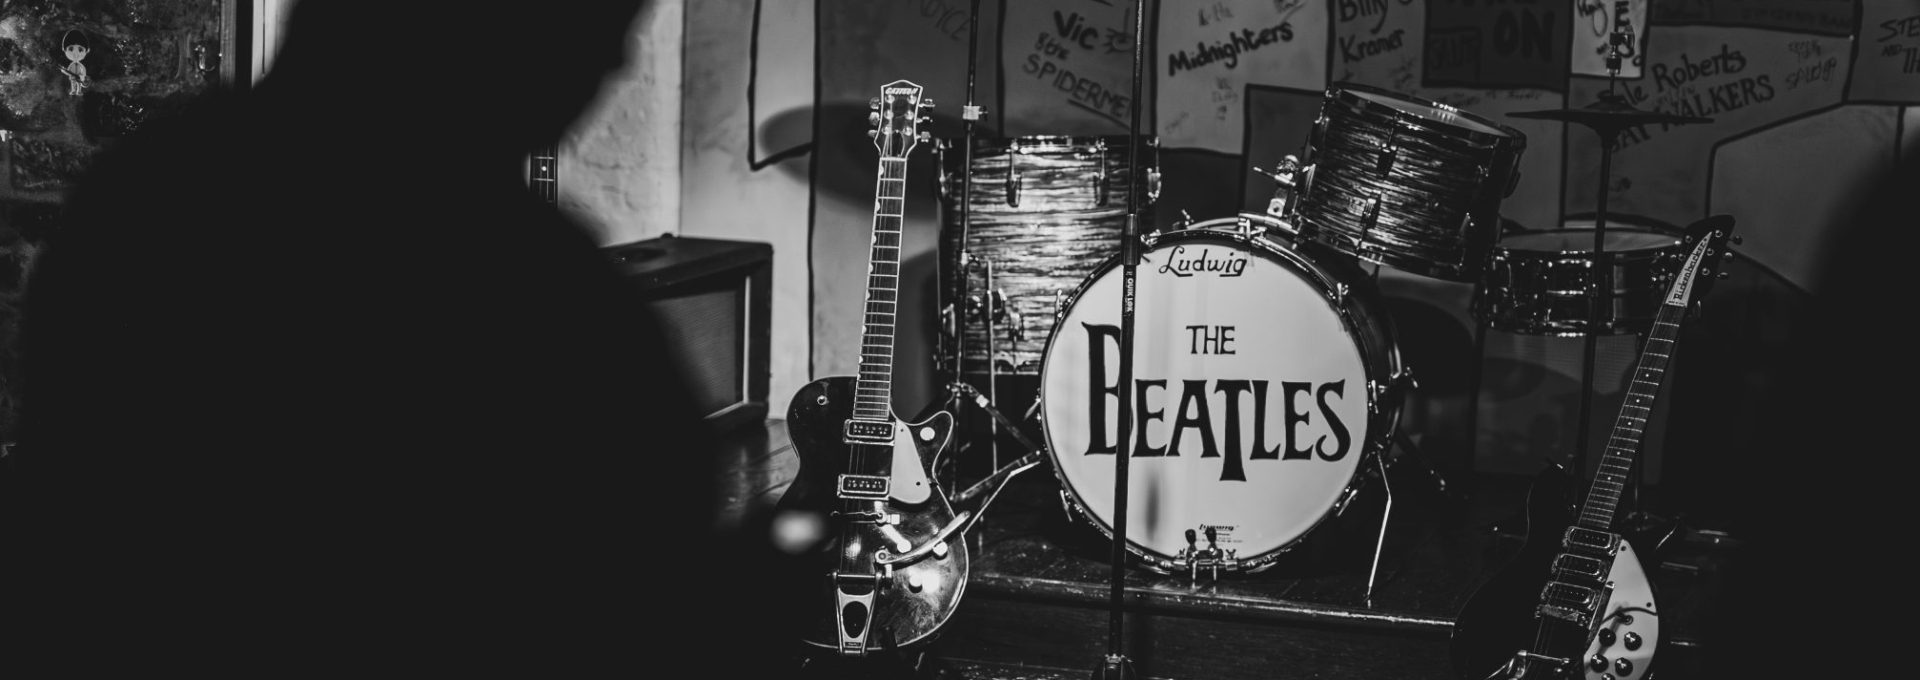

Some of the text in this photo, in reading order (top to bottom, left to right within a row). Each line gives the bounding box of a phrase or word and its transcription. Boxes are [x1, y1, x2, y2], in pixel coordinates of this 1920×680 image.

[1053, 9, 1099, 50] Vic
[1169, 22, 1293, 77] Midnighters
[1339, 29, 1405, 63] Kramer
[1494, 8, 1555, 62] ON
[1022, 53, 1131, 118] SPIDERME
[1652, 44, 1747, 92] Roberts
[1158, 245, 1248, 277] Ludwig
[1186, 325, 1236, 355] THE
[1081, 322, 1351, 481] BEATLES
